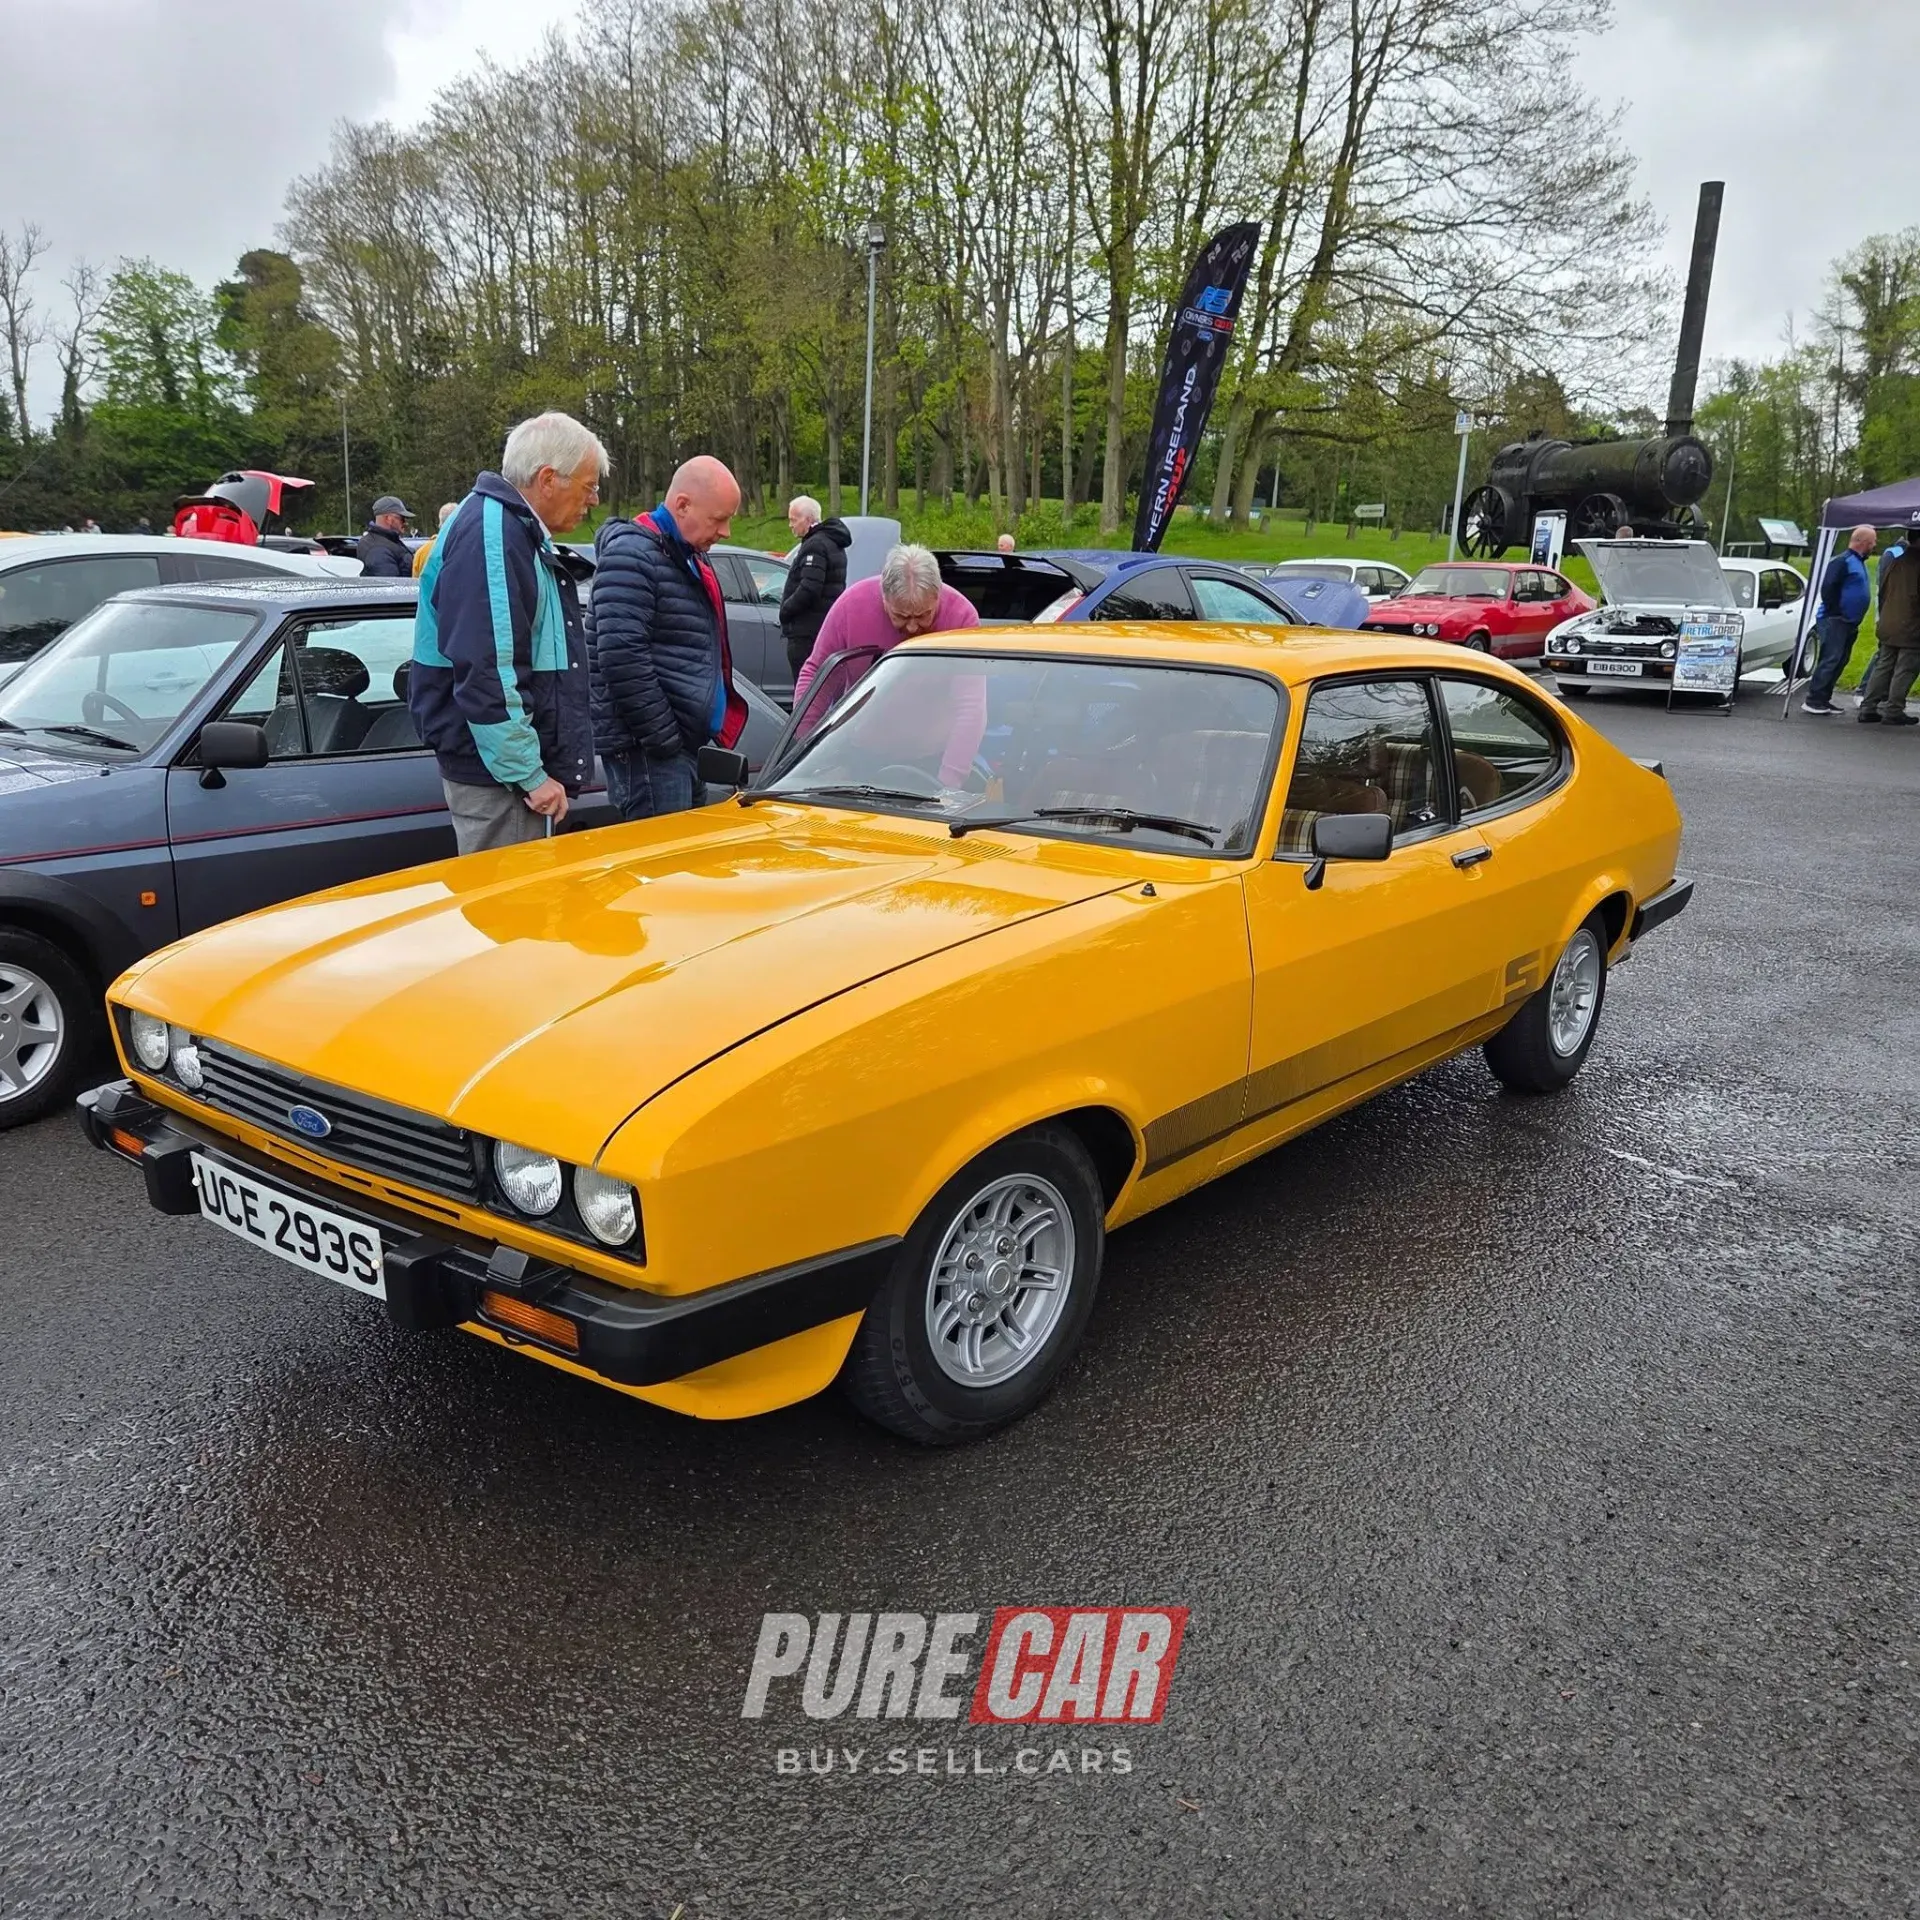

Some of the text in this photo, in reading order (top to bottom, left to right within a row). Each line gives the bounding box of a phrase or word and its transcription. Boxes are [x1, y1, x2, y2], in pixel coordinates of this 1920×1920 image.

[1231, 240, 1249, 264] RS
[1196, 286, 1233, 314] RS
[1163, 365, 1197, 472] IRELAND
[1687, 624, 1713, 636] RETRO
[297, 1110, 319, 1132] Ford
[197, 1164, 378, 1286] UCE 293S
